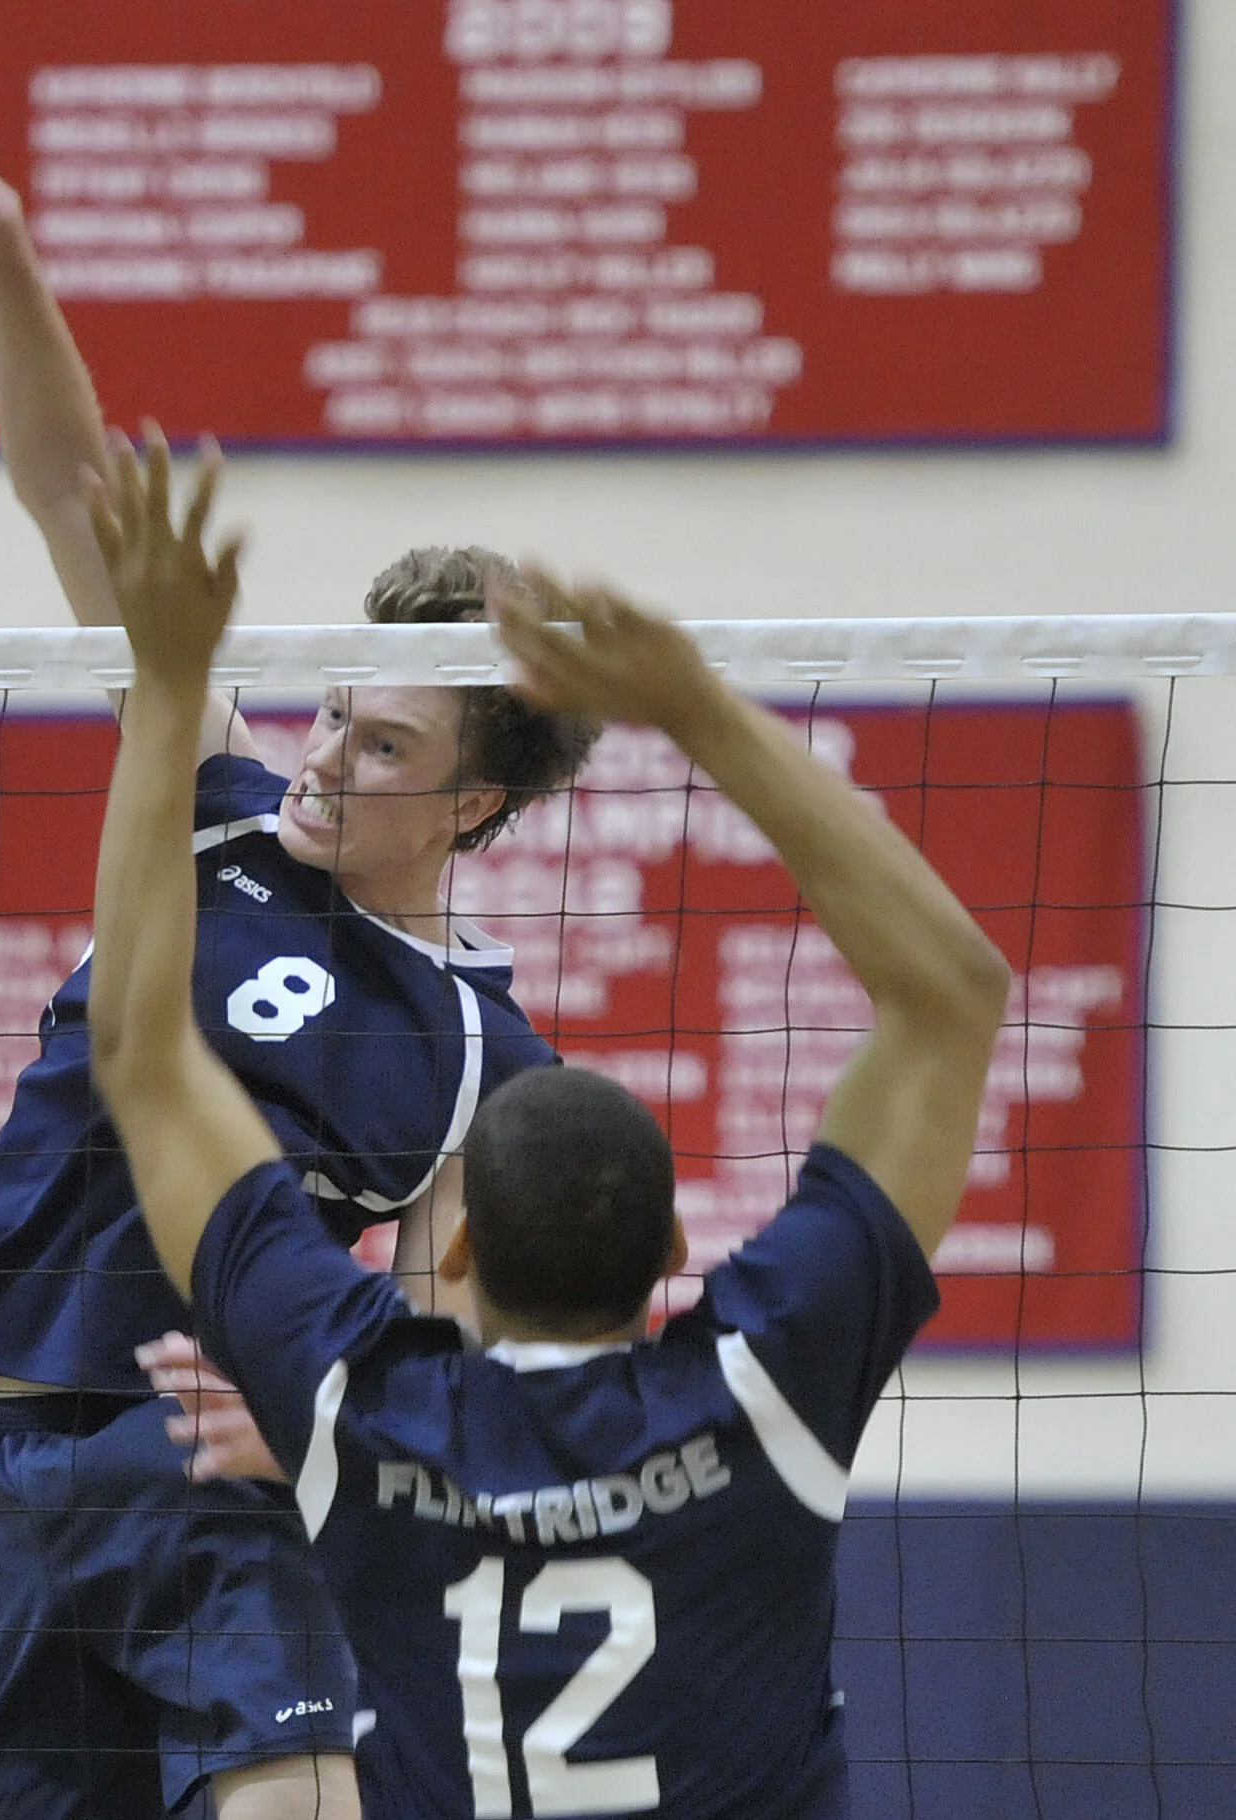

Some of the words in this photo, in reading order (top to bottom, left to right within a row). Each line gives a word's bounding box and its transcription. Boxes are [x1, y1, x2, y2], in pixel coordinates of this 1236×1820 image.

[233, 873, 273, 904] asics
[227, 956, 336, 1042] 8
[444, 1555, 661, 1820] 12
